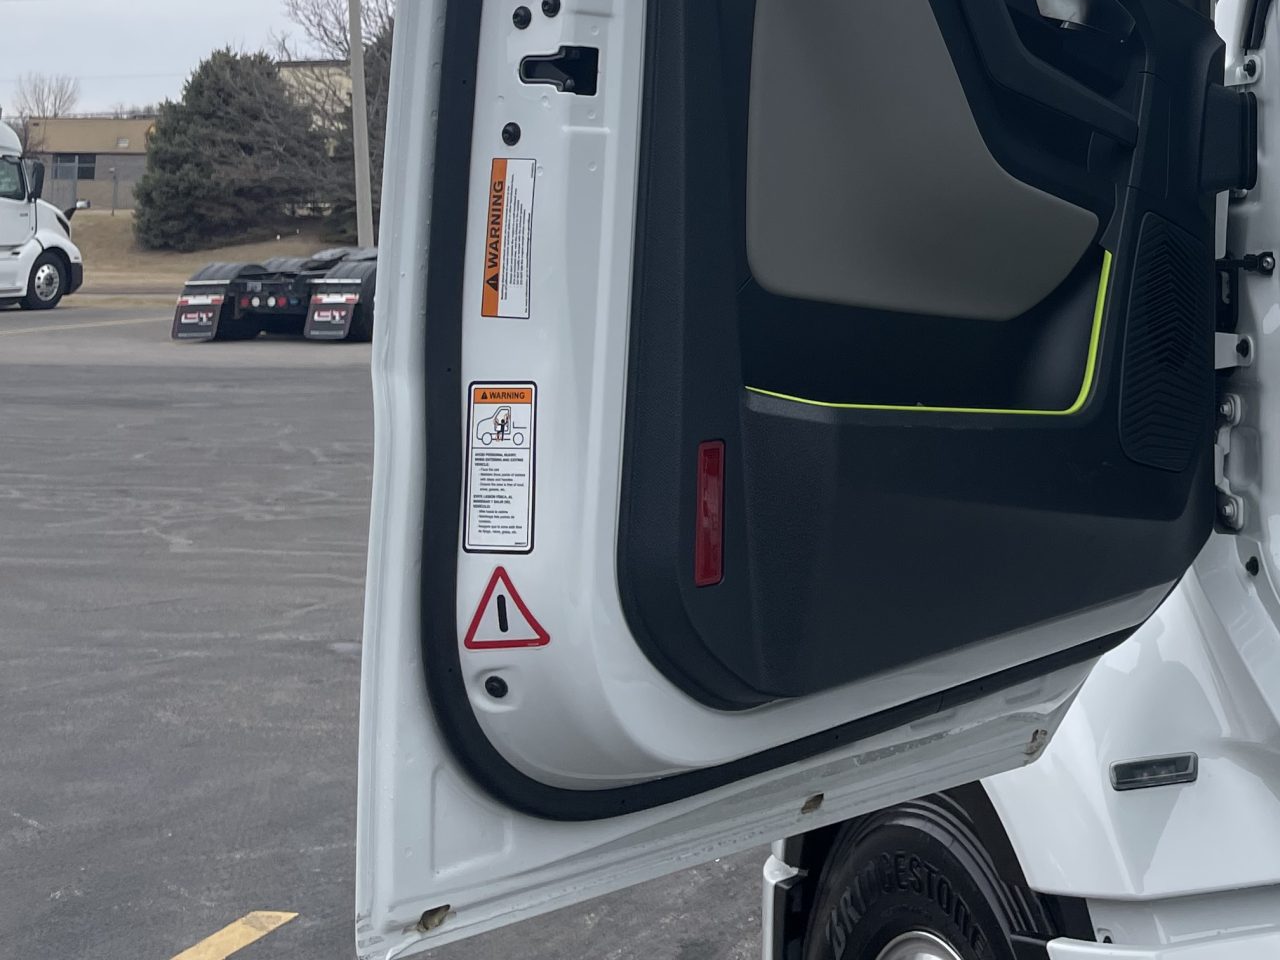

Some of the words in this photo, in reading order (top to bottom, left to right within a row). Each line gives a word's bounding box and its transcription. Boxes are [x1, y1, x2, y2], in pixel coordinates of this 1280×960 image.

[487, 180, 504, 269] WARNING
[489, 389, 525, 400] WARNING
[826, 849, 990, 960] BRIDGESTONE
